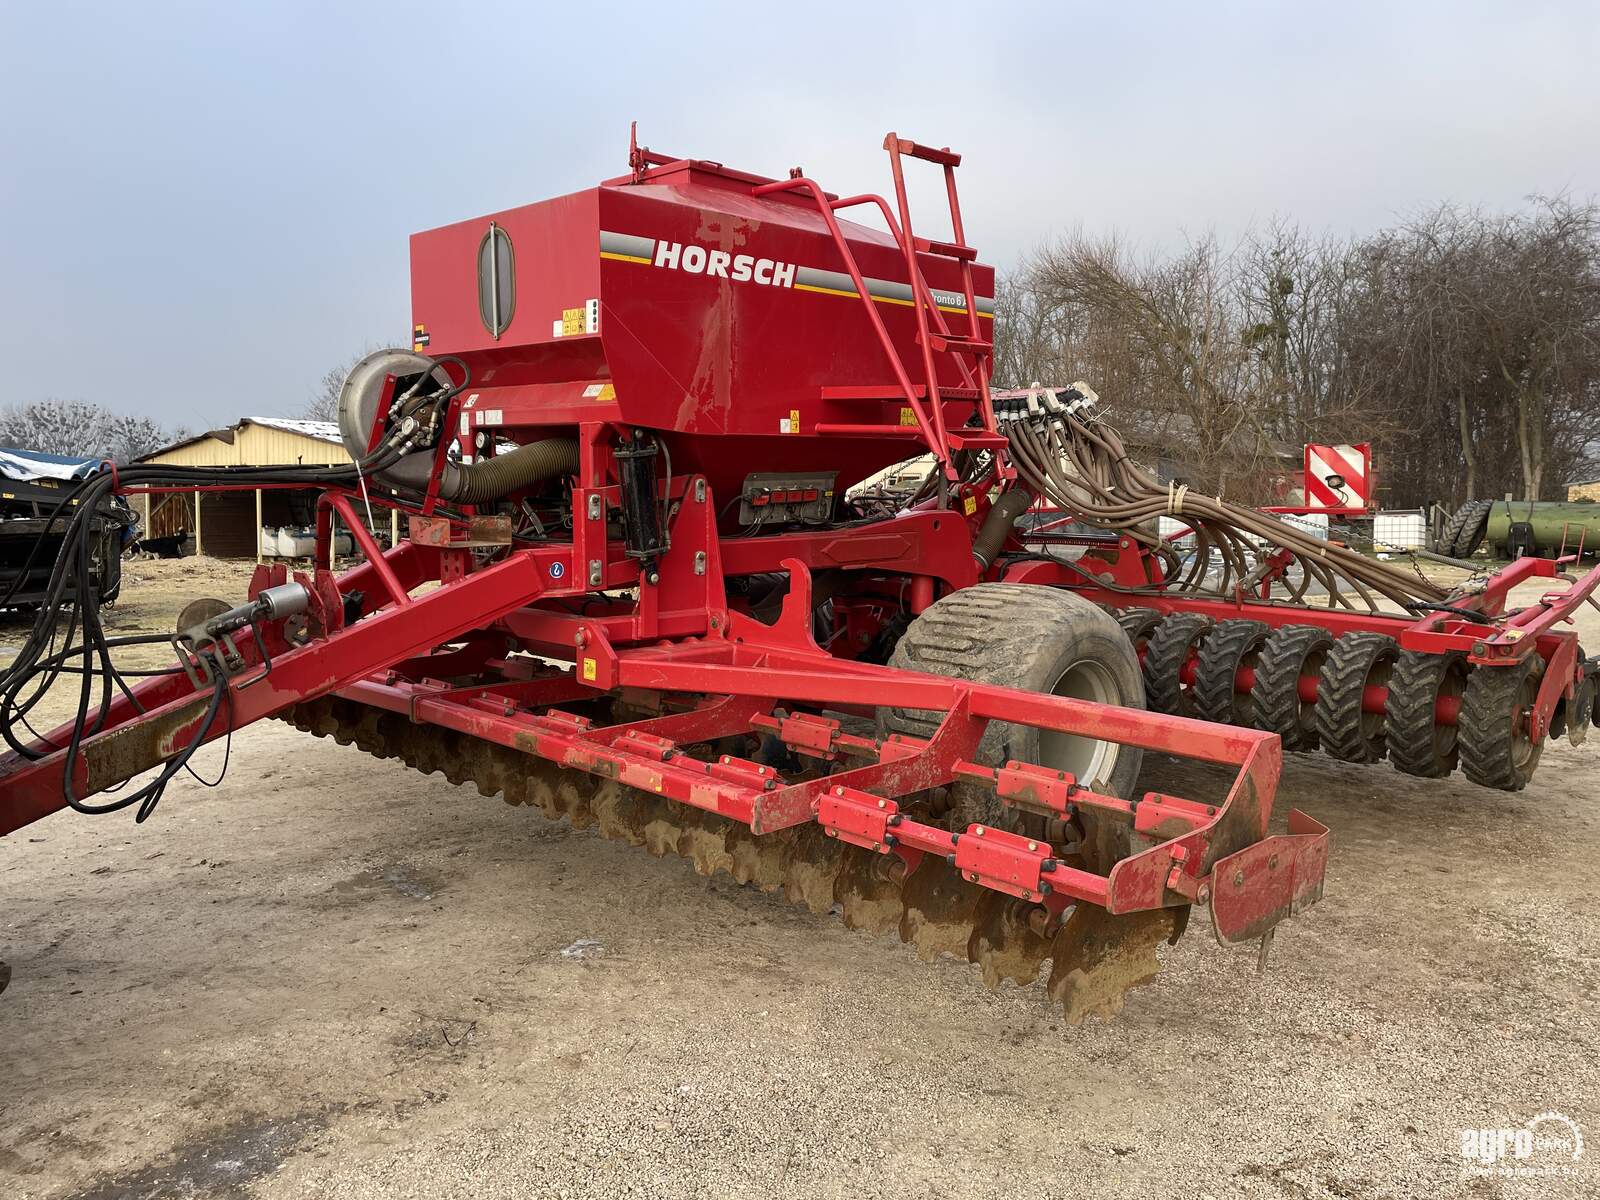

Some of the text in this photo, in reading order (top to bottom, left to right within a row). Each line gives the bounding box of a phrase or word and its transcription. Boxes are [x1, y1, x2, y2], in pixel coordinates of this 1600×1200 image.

[654, 240, 796, 289] HORSCH
[931, 292, 956, 305] ronto
[956, 295, 962, 306] 6
